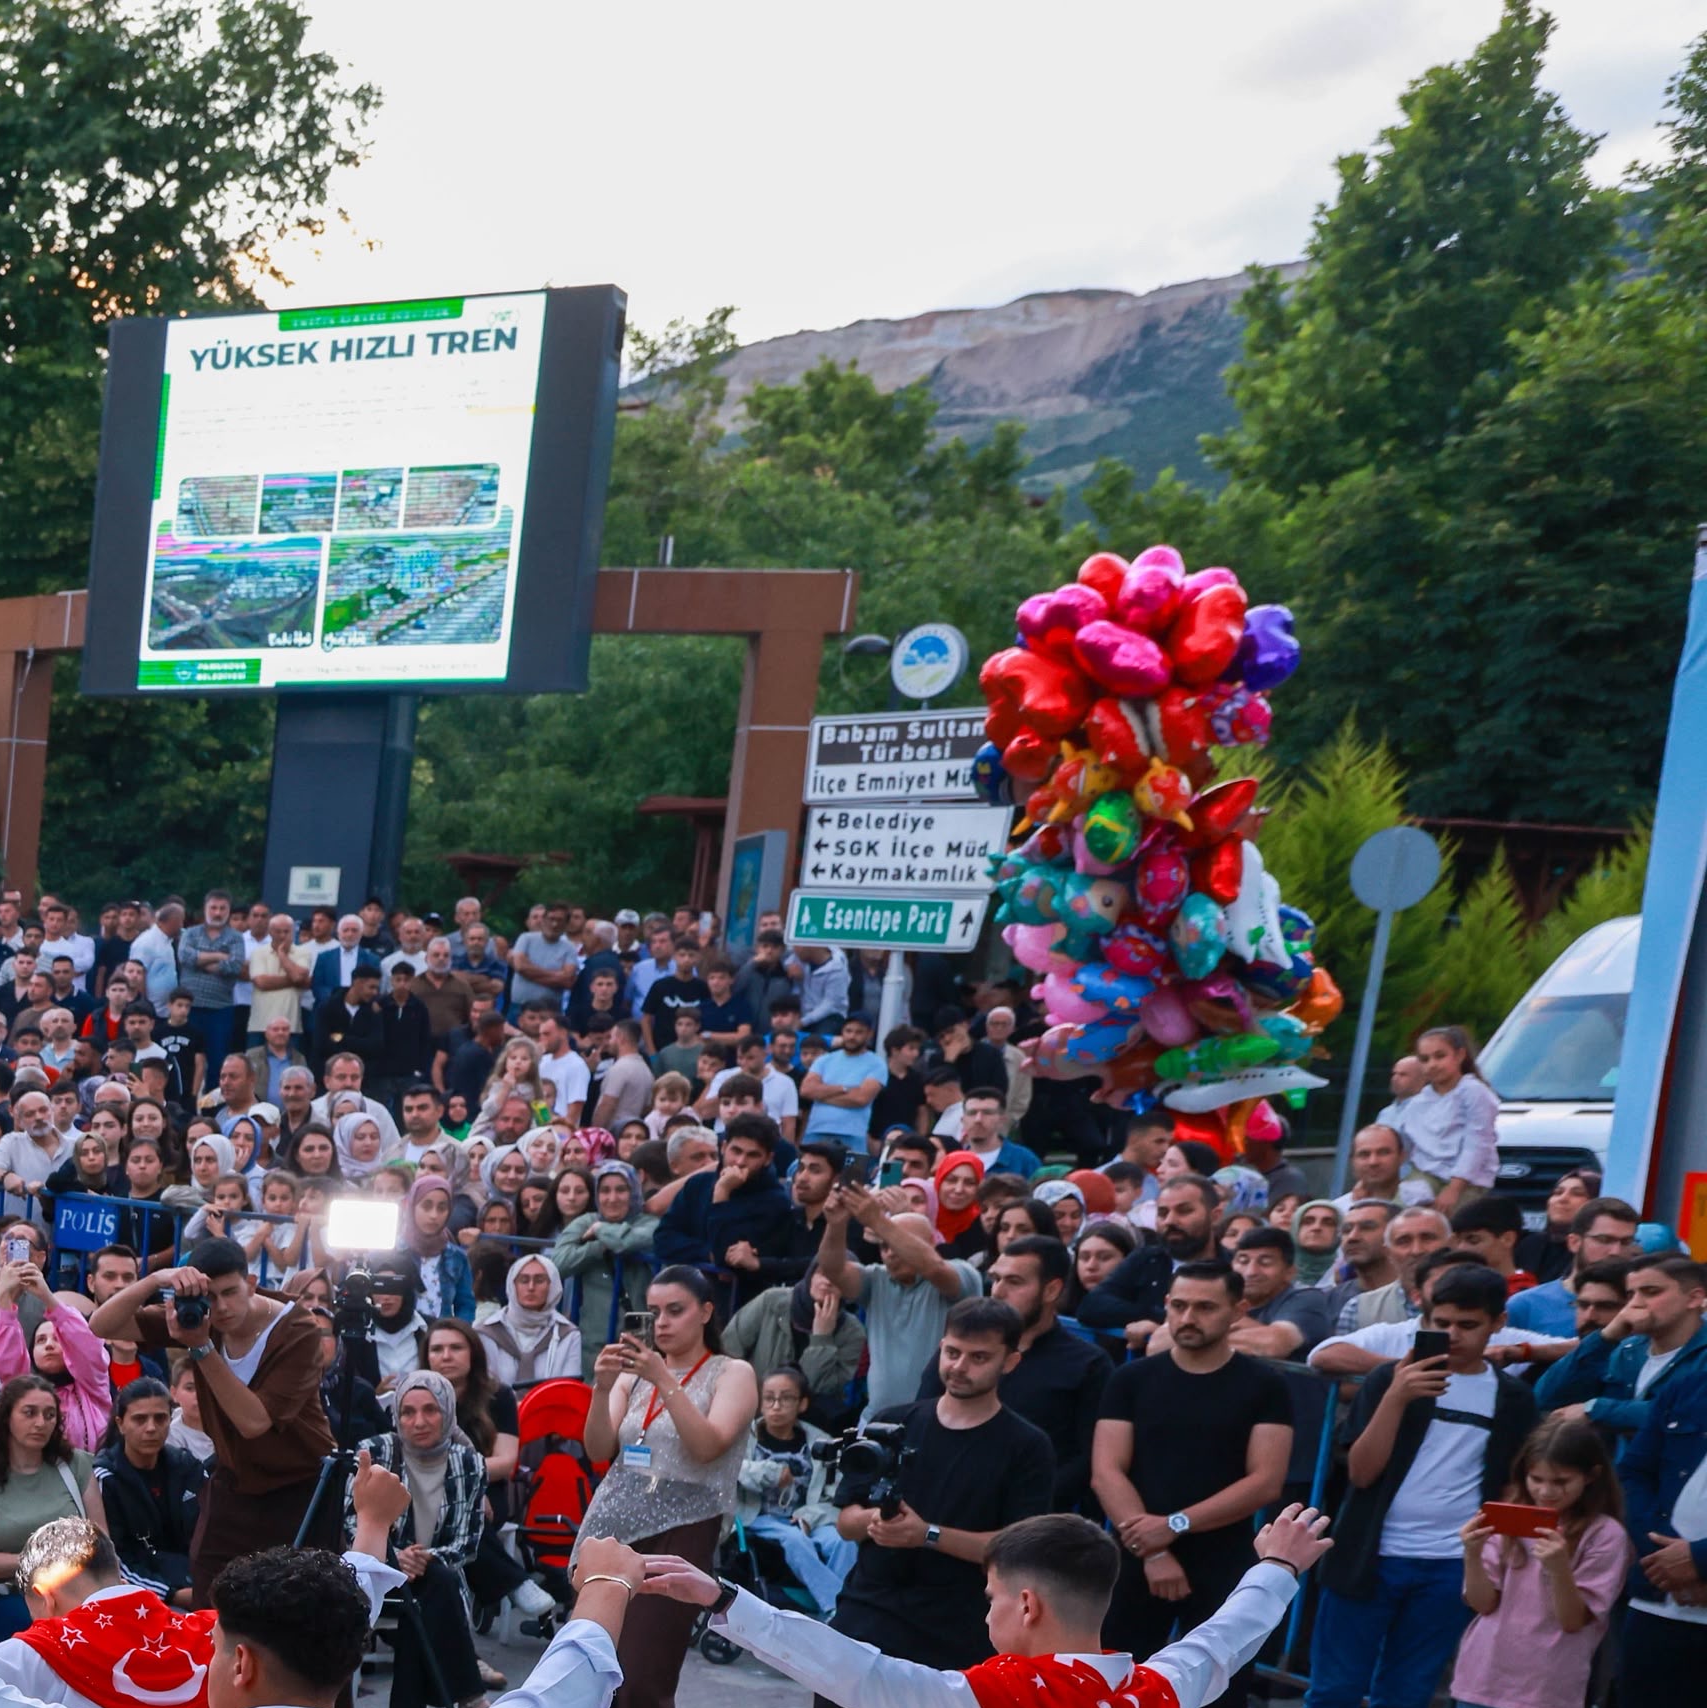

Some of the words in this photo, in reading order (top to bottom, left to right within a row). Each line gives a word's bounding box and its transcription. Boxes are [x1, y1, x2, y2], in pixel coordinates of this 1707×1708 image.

[190, 339, 319, 371] YÜKSEK
[330, 334, 415, 363] HIZLI
[427, 327, 518, 356] TREN
[822, 725, 898, 744] Babam
[907, 718, 985, 741] Sultan
[859, 740, 951, 763] Türbesi
[812, 770, 847, 794] İlçe
[856, 770, 935, 795] Emniyet
[945, 767, 971, 789] Mü
[837, 813, 935, 833] Belediye
[833, 840, 880, 857] SGK
[891, 836, 934, 859] İlçe
[830, 863, 977, 883] Kaymakamlık
[823, 901, 902, 938] Esentepe
[906, 904, 947, 934] Park
[60, 1208, 116, 1235] POLİS
